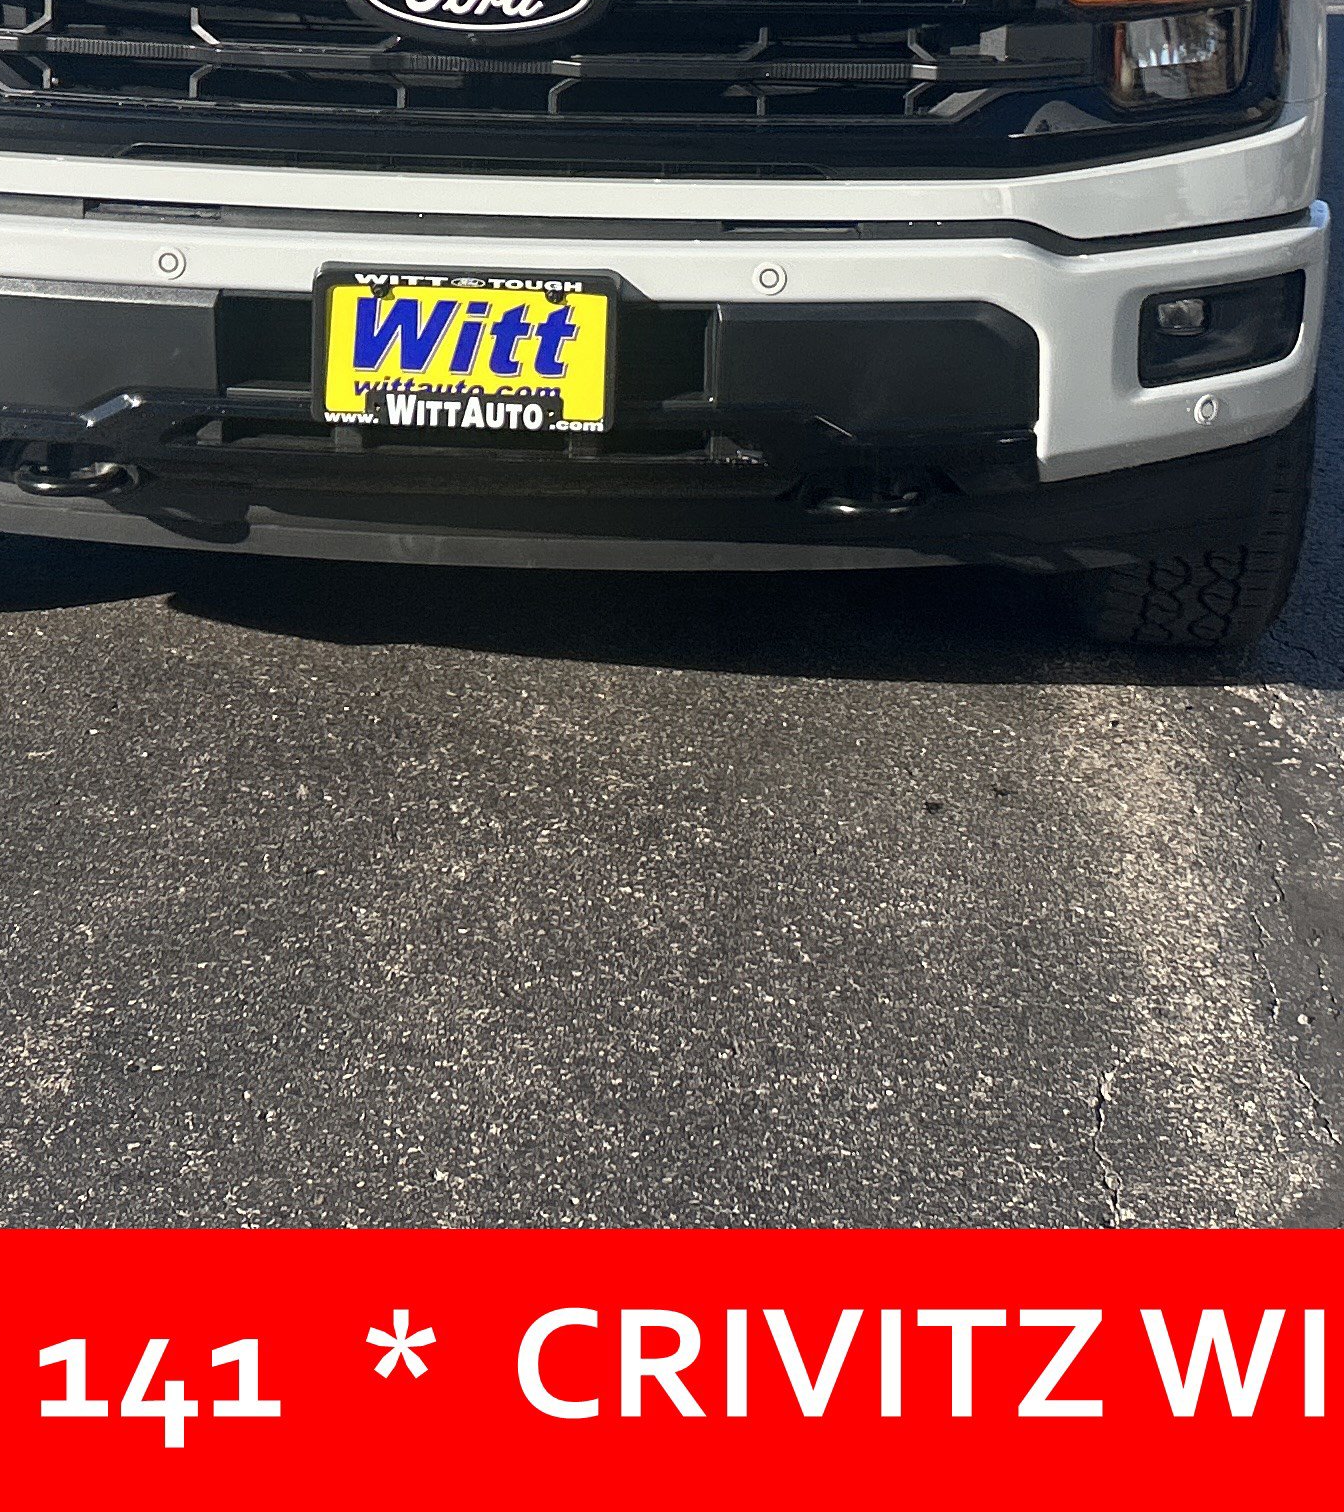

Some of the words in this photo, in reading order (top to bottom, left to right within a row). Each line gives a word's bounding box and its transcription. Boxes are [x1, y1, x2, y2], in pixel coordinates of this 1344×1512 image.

[354, 273, 449, 287] WITT
[487, 278, 583, 292] TOUGH
[353, 296, 580, 379] Witt
[354, 376, 561, 398] wittautocom
[324, 410, 379, 425] www.
